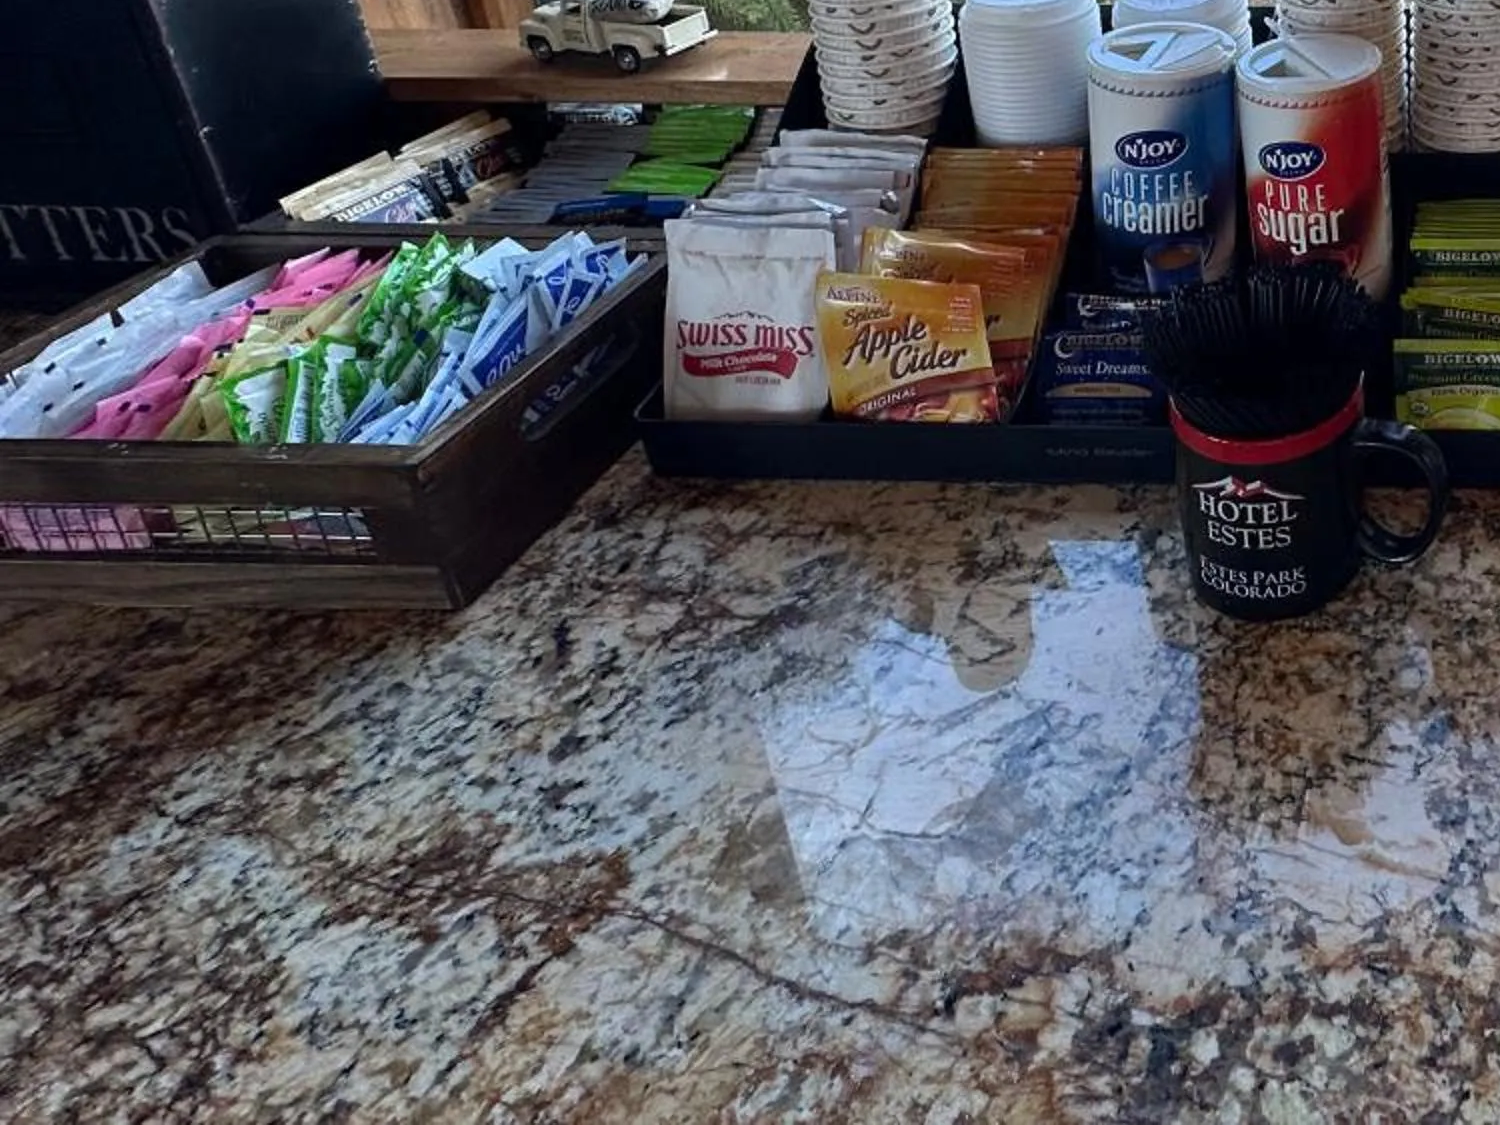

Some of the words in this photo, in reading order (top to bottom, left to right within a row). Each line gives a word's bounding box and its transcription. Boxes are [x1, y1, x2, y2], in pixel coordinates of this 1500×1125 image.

[1111, 168, 1193, 202] COFFEE
[1265, 180, 1325, 213] PURE
[1103, 192, 1209, 235] creamer
[843, 301, 893, 327] Spiced
[843, 315, 928, 365] Apple
[890, 342, 967, 379] Cider
[1055, 362, 1091, 375] Sweet
[860, 386, 918, 415] ORIGINAL
[1199, 490, 1298, 524] HOTEL
[1207, 519, 1291, 550] ESTES
[1200, 554, 1248, 584] ESTES
[1252, 566, 1305, 586] PARK
[1201, 566, 1307, 598] COLORADO
